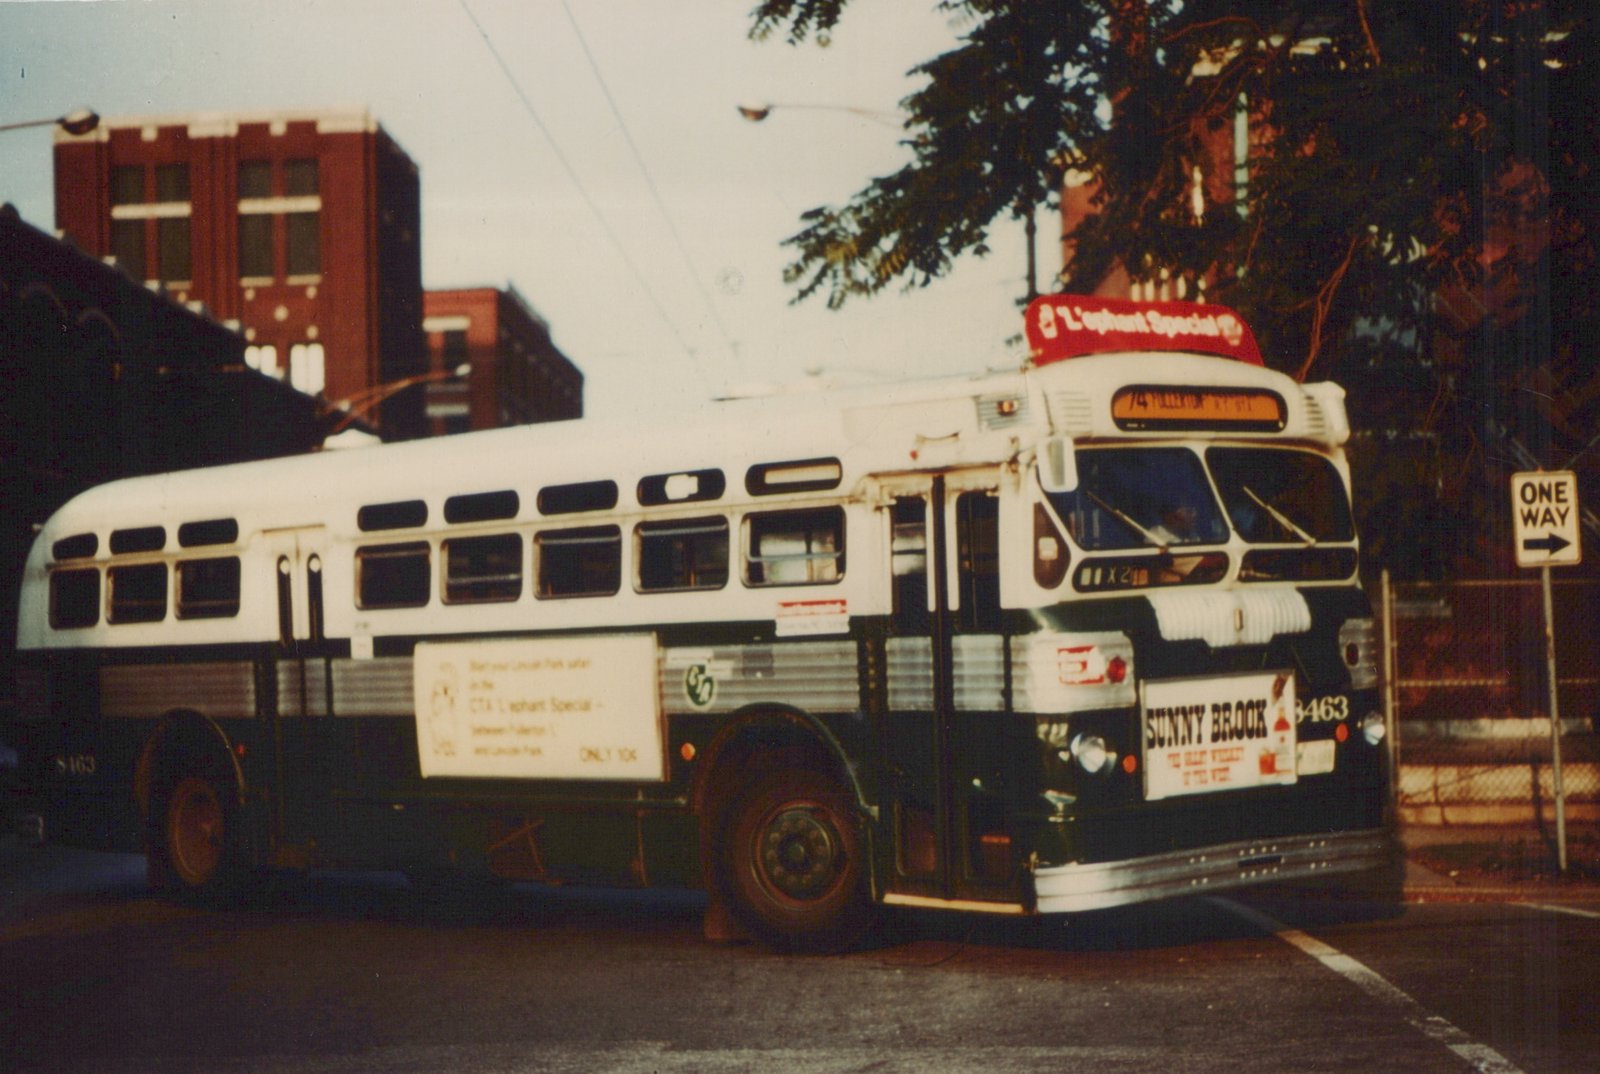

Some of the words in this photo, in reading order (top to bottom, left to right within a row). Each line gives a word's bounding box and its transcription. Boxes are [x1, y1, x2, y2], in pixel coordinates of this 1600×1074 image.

[1520, 481, 1568, 505] ONE
[1520, 505, 1570, 528] WAY
[1146, 704, 1206, 750] SUNNY
[1210, 699, 1268, 743] BROOK
